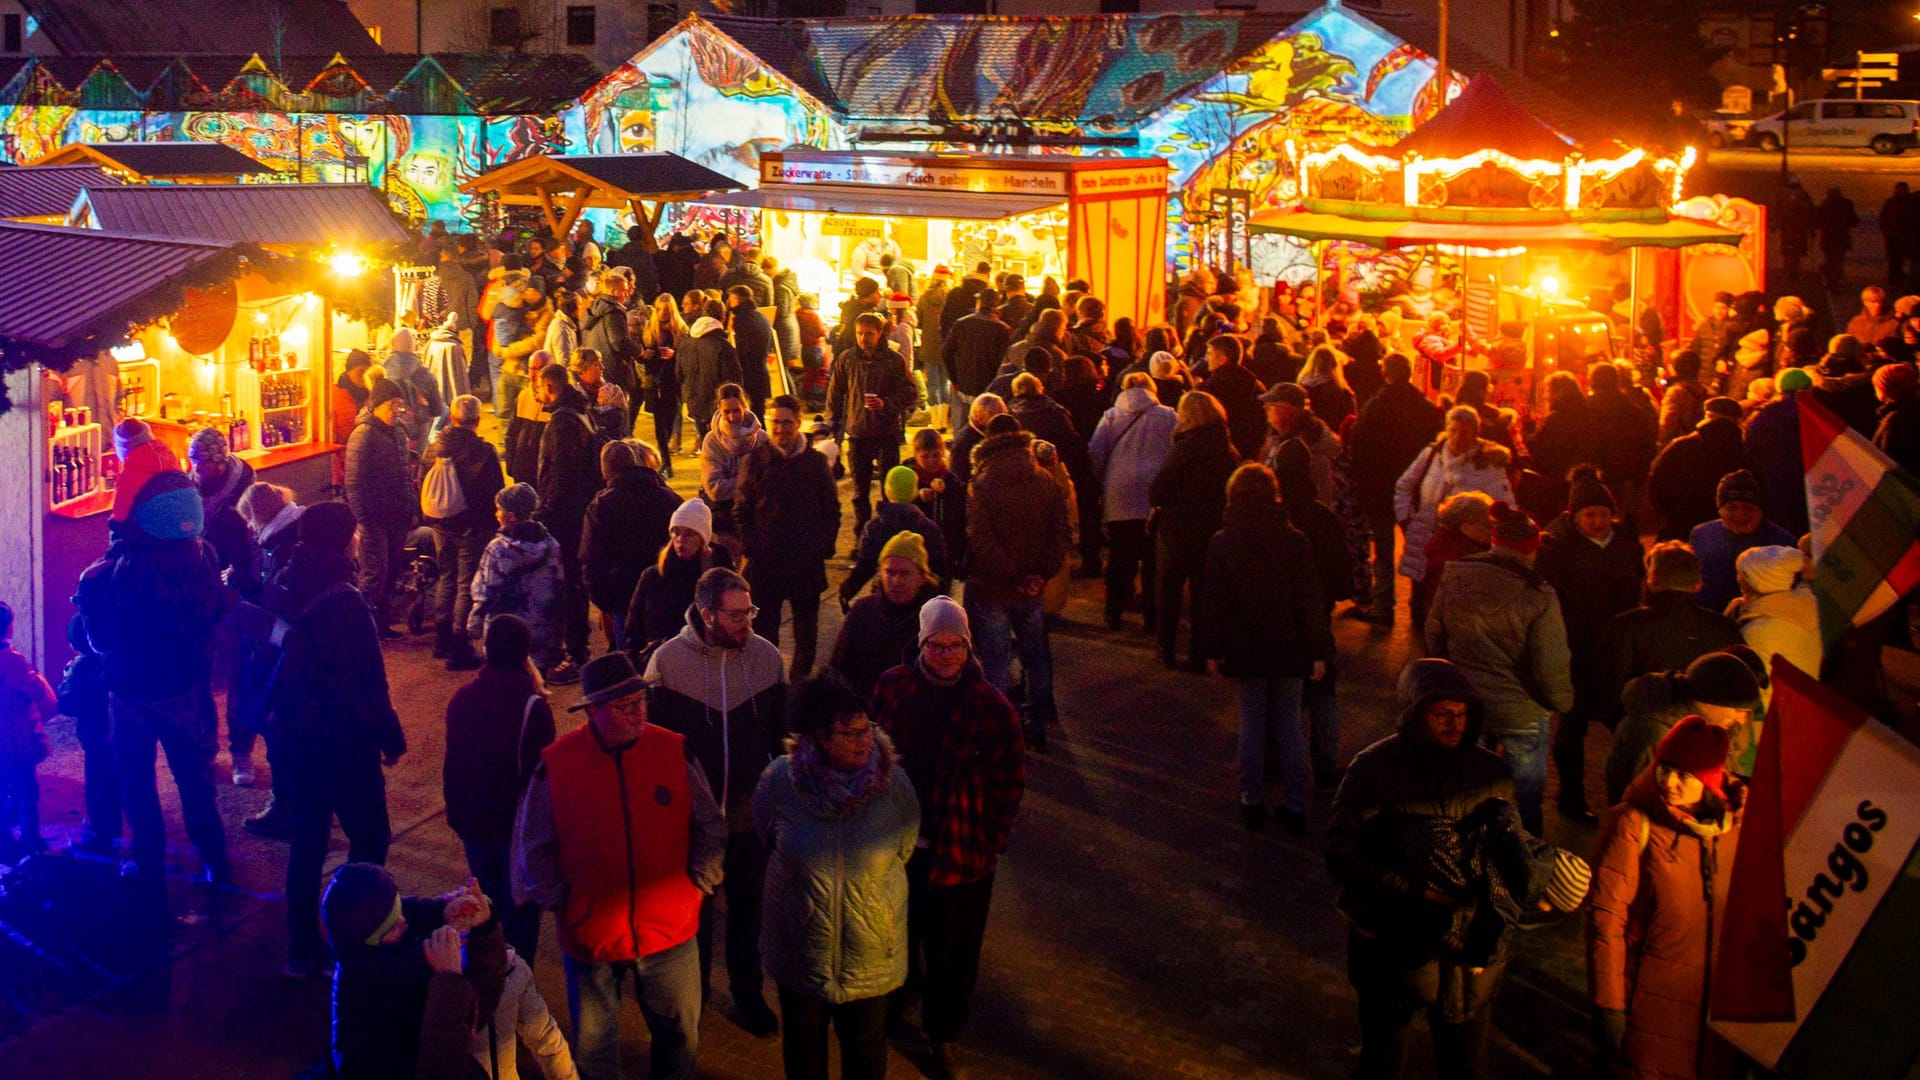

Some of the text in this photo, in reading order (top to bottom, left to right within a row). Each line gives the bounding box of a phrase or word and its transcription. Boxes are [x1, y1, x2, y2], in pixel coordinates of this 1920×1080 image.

[771, 165, 832, 180] Zuckerwatte
[905, 171, 935, 185] frisch
[1004, 174, 1056, 189] Mandeln
